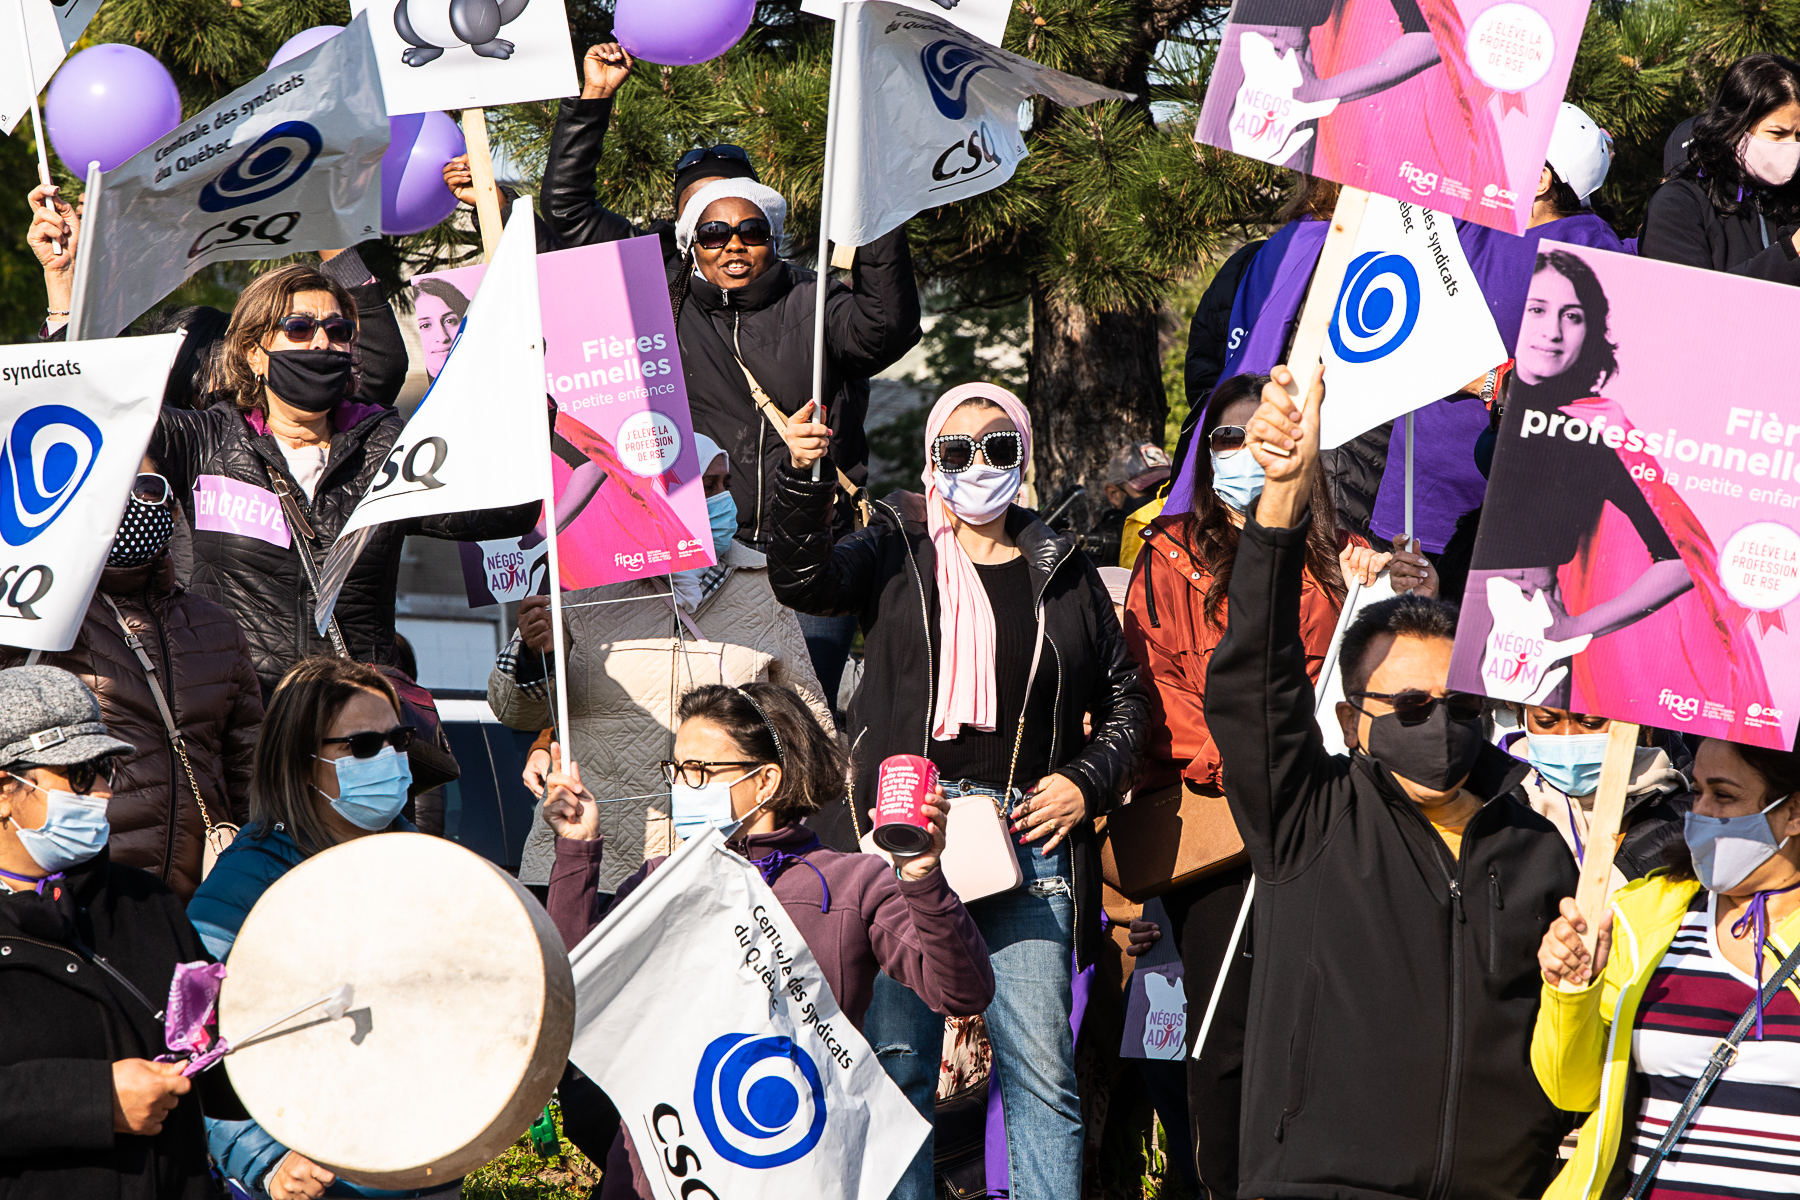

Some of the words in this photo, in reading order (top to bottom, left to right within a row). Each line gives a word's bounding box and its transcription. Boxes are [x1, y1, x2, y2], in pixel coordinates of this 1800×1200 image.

[1479, 34, 1542, 62] PROFESSION
[1529, 32, 1542, 46] LA
[1488, 52, 1502, 66] DE
[1504, 57, 1525, 73] RSE
[1242, 88, 1292, 117] NÉGOS
[154, 122, 211, 163] Centrale
[213, 107, 239, 131] des
[240, 72, 305, 116] syndicats
[154, 165, 173, 184] du
[176, 137, 234, 173] Québec
[932, 120, 1002, 182] CSQ
[186, 211, 302, 259] CSQ
[1427, 232, 1458, 297] syndicats
[582, 333, 667, 363] Fières
[1228, 327, 1248, 350] S
[2, 359, 82, 386] syndicats
[572, 394, 614, 412] petite
[618, 383, 675, 402] enfance
[658, 424, 668, 435] LA
[625, 436, 674, 452] PROFESSION
[638, 452, 648, 462] DE
[650, 448, 666, 460] RSE
[362, 436, 448, 497] SQ
[1630, 462, 1658, 482] de
[1662, 467, 1680, 486] la
[1684, 472, 1744, 498] petite
[200, 490, 216, 516] EN
[218, 492, 284, 532] GRÈVE
[486, 552, 524, 570] NÉGOS
[1732, 555, 1798, 578] PROFESSION
[1784, 550, 1796, 562] LA
[1743, 573, 1757, 586] DE
[1760, 576, 1781, 590] RSE
[1493, 630, 1544, 657] NÉGOS
[734, 924, 752, 948] du
[786, 977, 808, 1002] des
[802, 1002, 853, 1070] syndicats
[1149, 1008, 1184, 1026] NÉGOS
